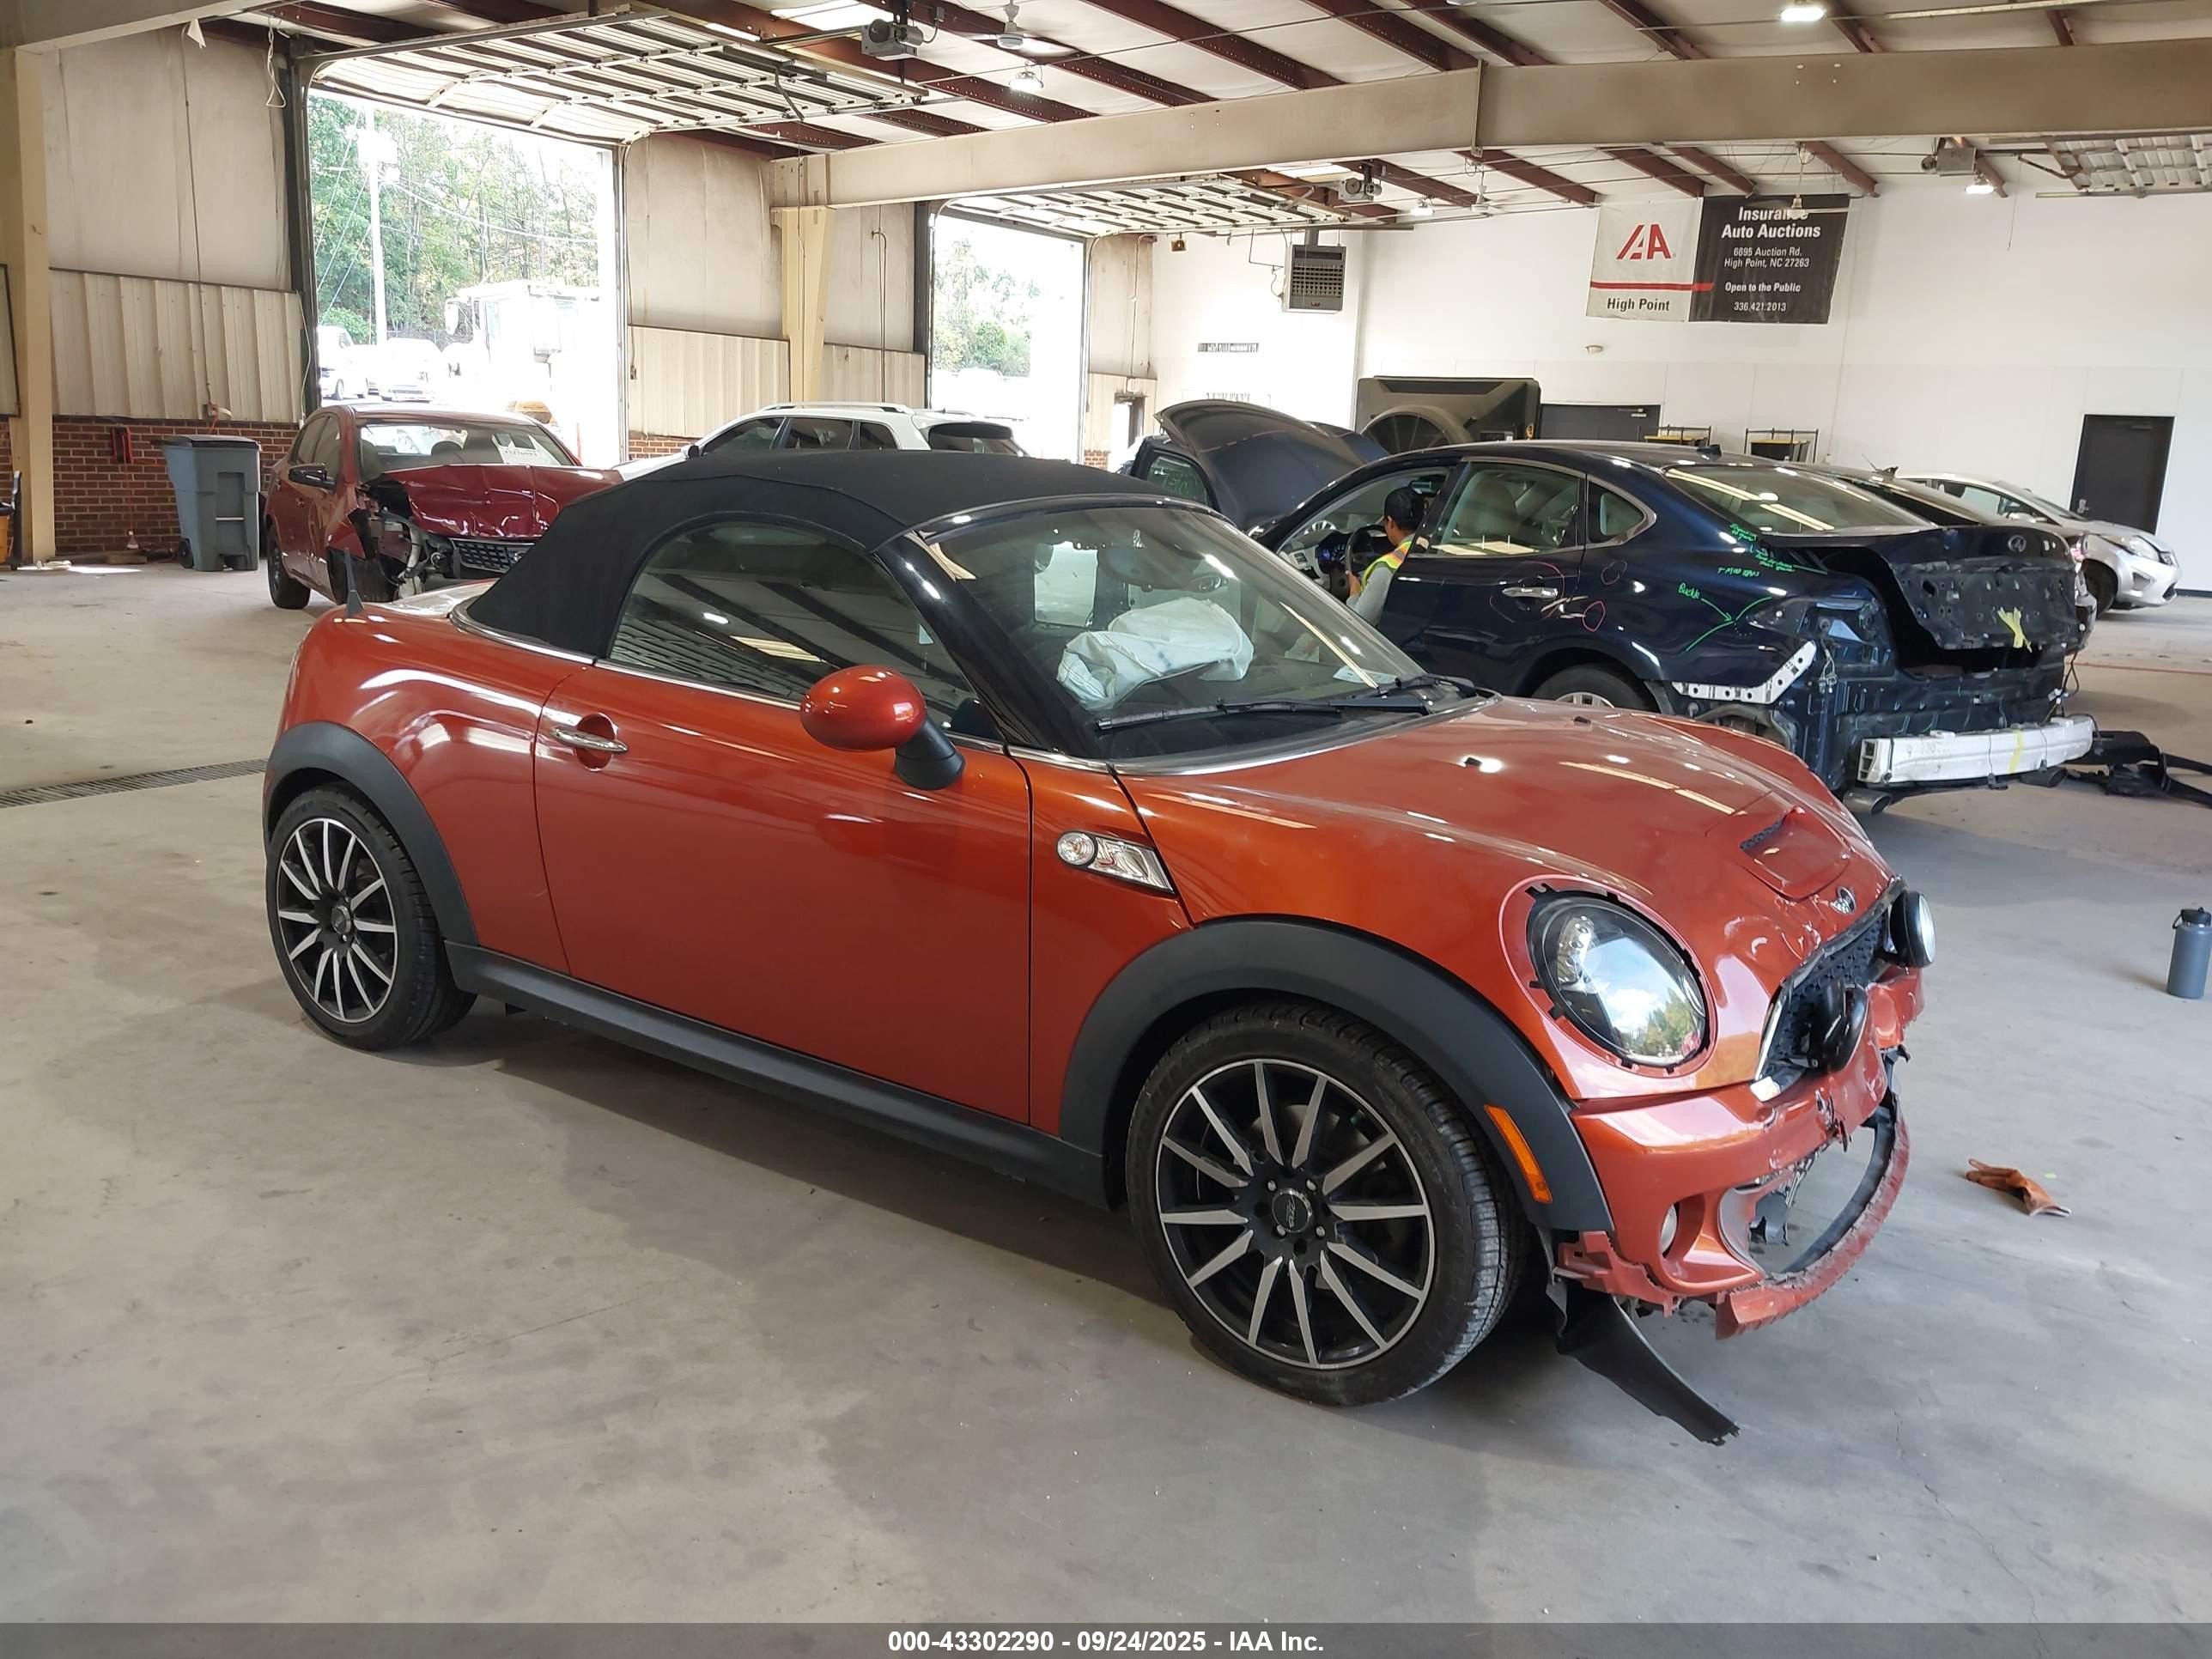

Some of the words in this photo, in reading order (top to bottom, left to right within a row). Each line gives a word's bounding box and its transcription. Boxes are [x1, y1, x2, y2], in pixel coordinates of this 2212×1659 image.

[1722, 223, 1754, 238] Auto
[1757, 223, 1821, 238] Auctions
[1733, 247, 1753, 257] 6695
[1754, 246, 1787, 257] Auction
[1724, 258, 1743, 270] High
[1745, 258, 1767, 269] Point,
[1770, 258, 1783, 268] NC
[1784, 258, 1810, 268] 27263
[1724, 282, 1747, 294] Open
[1748, 283, 1757, 292] to
[1758, 283, 1771, 292] the
[1773, 283, 1802, 292] Public
[1607, 297, 1635, 313] High
[1638, 298, 1670, 312] Point
[1734, 301, 1787, 312] 336.421.2013
